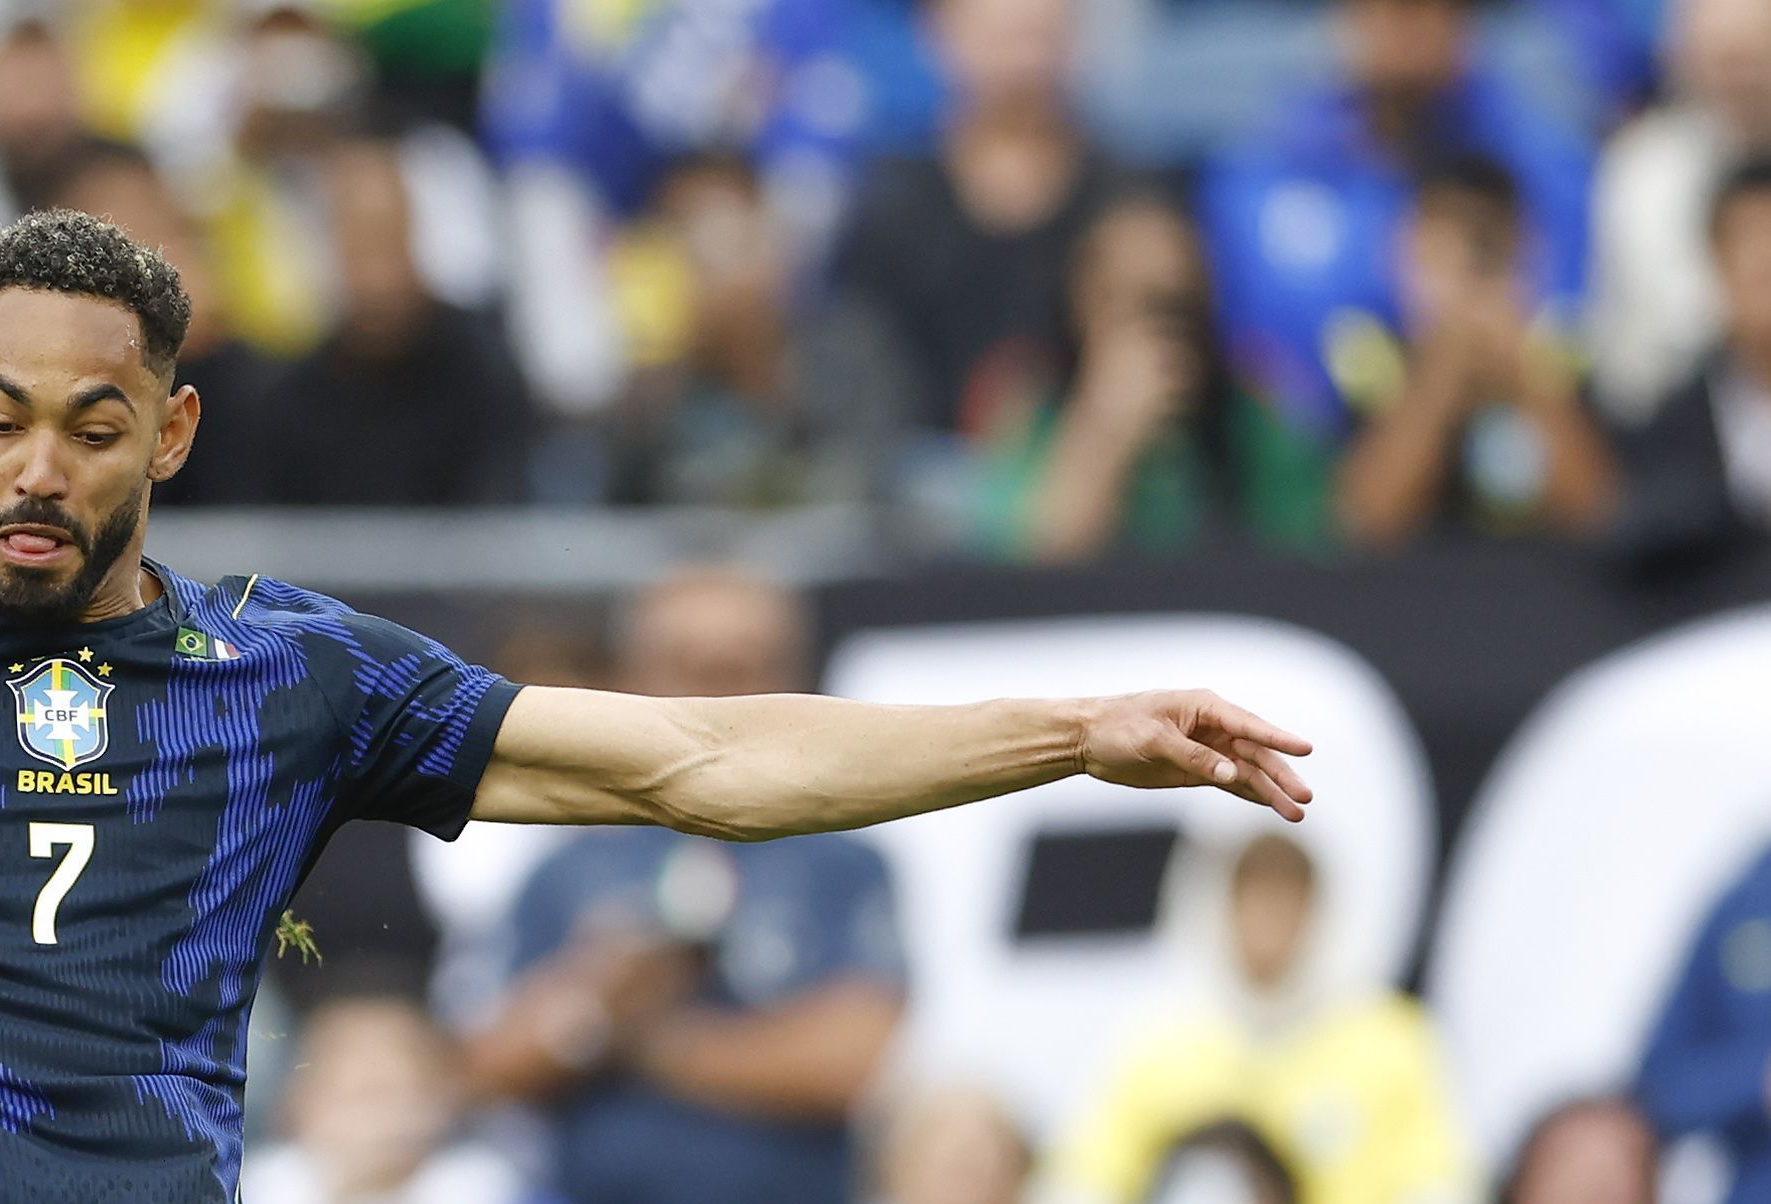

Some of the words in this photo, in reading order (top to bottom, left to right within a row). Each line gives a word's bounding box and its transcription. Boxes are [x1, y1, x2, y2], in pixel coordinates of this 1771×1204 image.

[44, 709, 78, 722] CBF
[17, 770, 118, 795] BRASIL
[28, 822, 95, 945] 7
